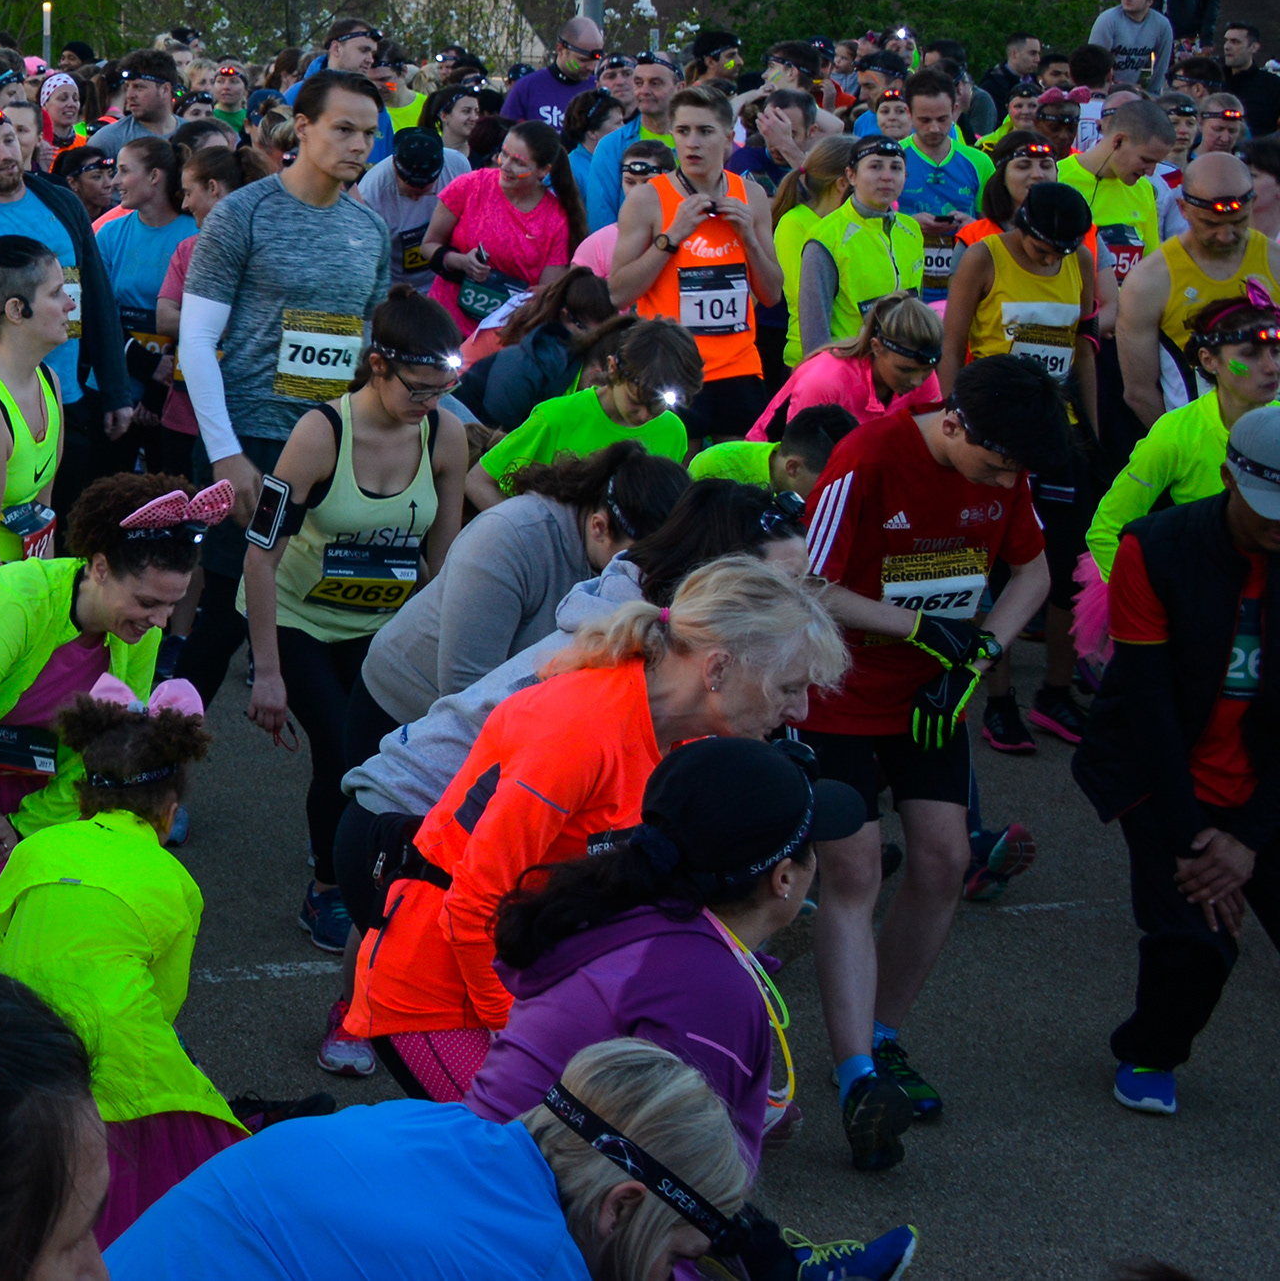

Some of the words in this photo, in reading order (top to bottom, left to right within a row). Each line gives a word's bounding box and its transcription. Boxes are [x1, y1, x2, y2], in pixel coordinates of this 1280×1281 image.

[693, 297, 738, 322] 104
[287, 344, 354, 368] 70674
[911, 535, 966, 553] TOWER
[890, 553, 934, 567] exercise
[882, 566, 979, 583] determination
[316, 581, 405, 609] 2069
[889, 590, 973, 612] 70672
